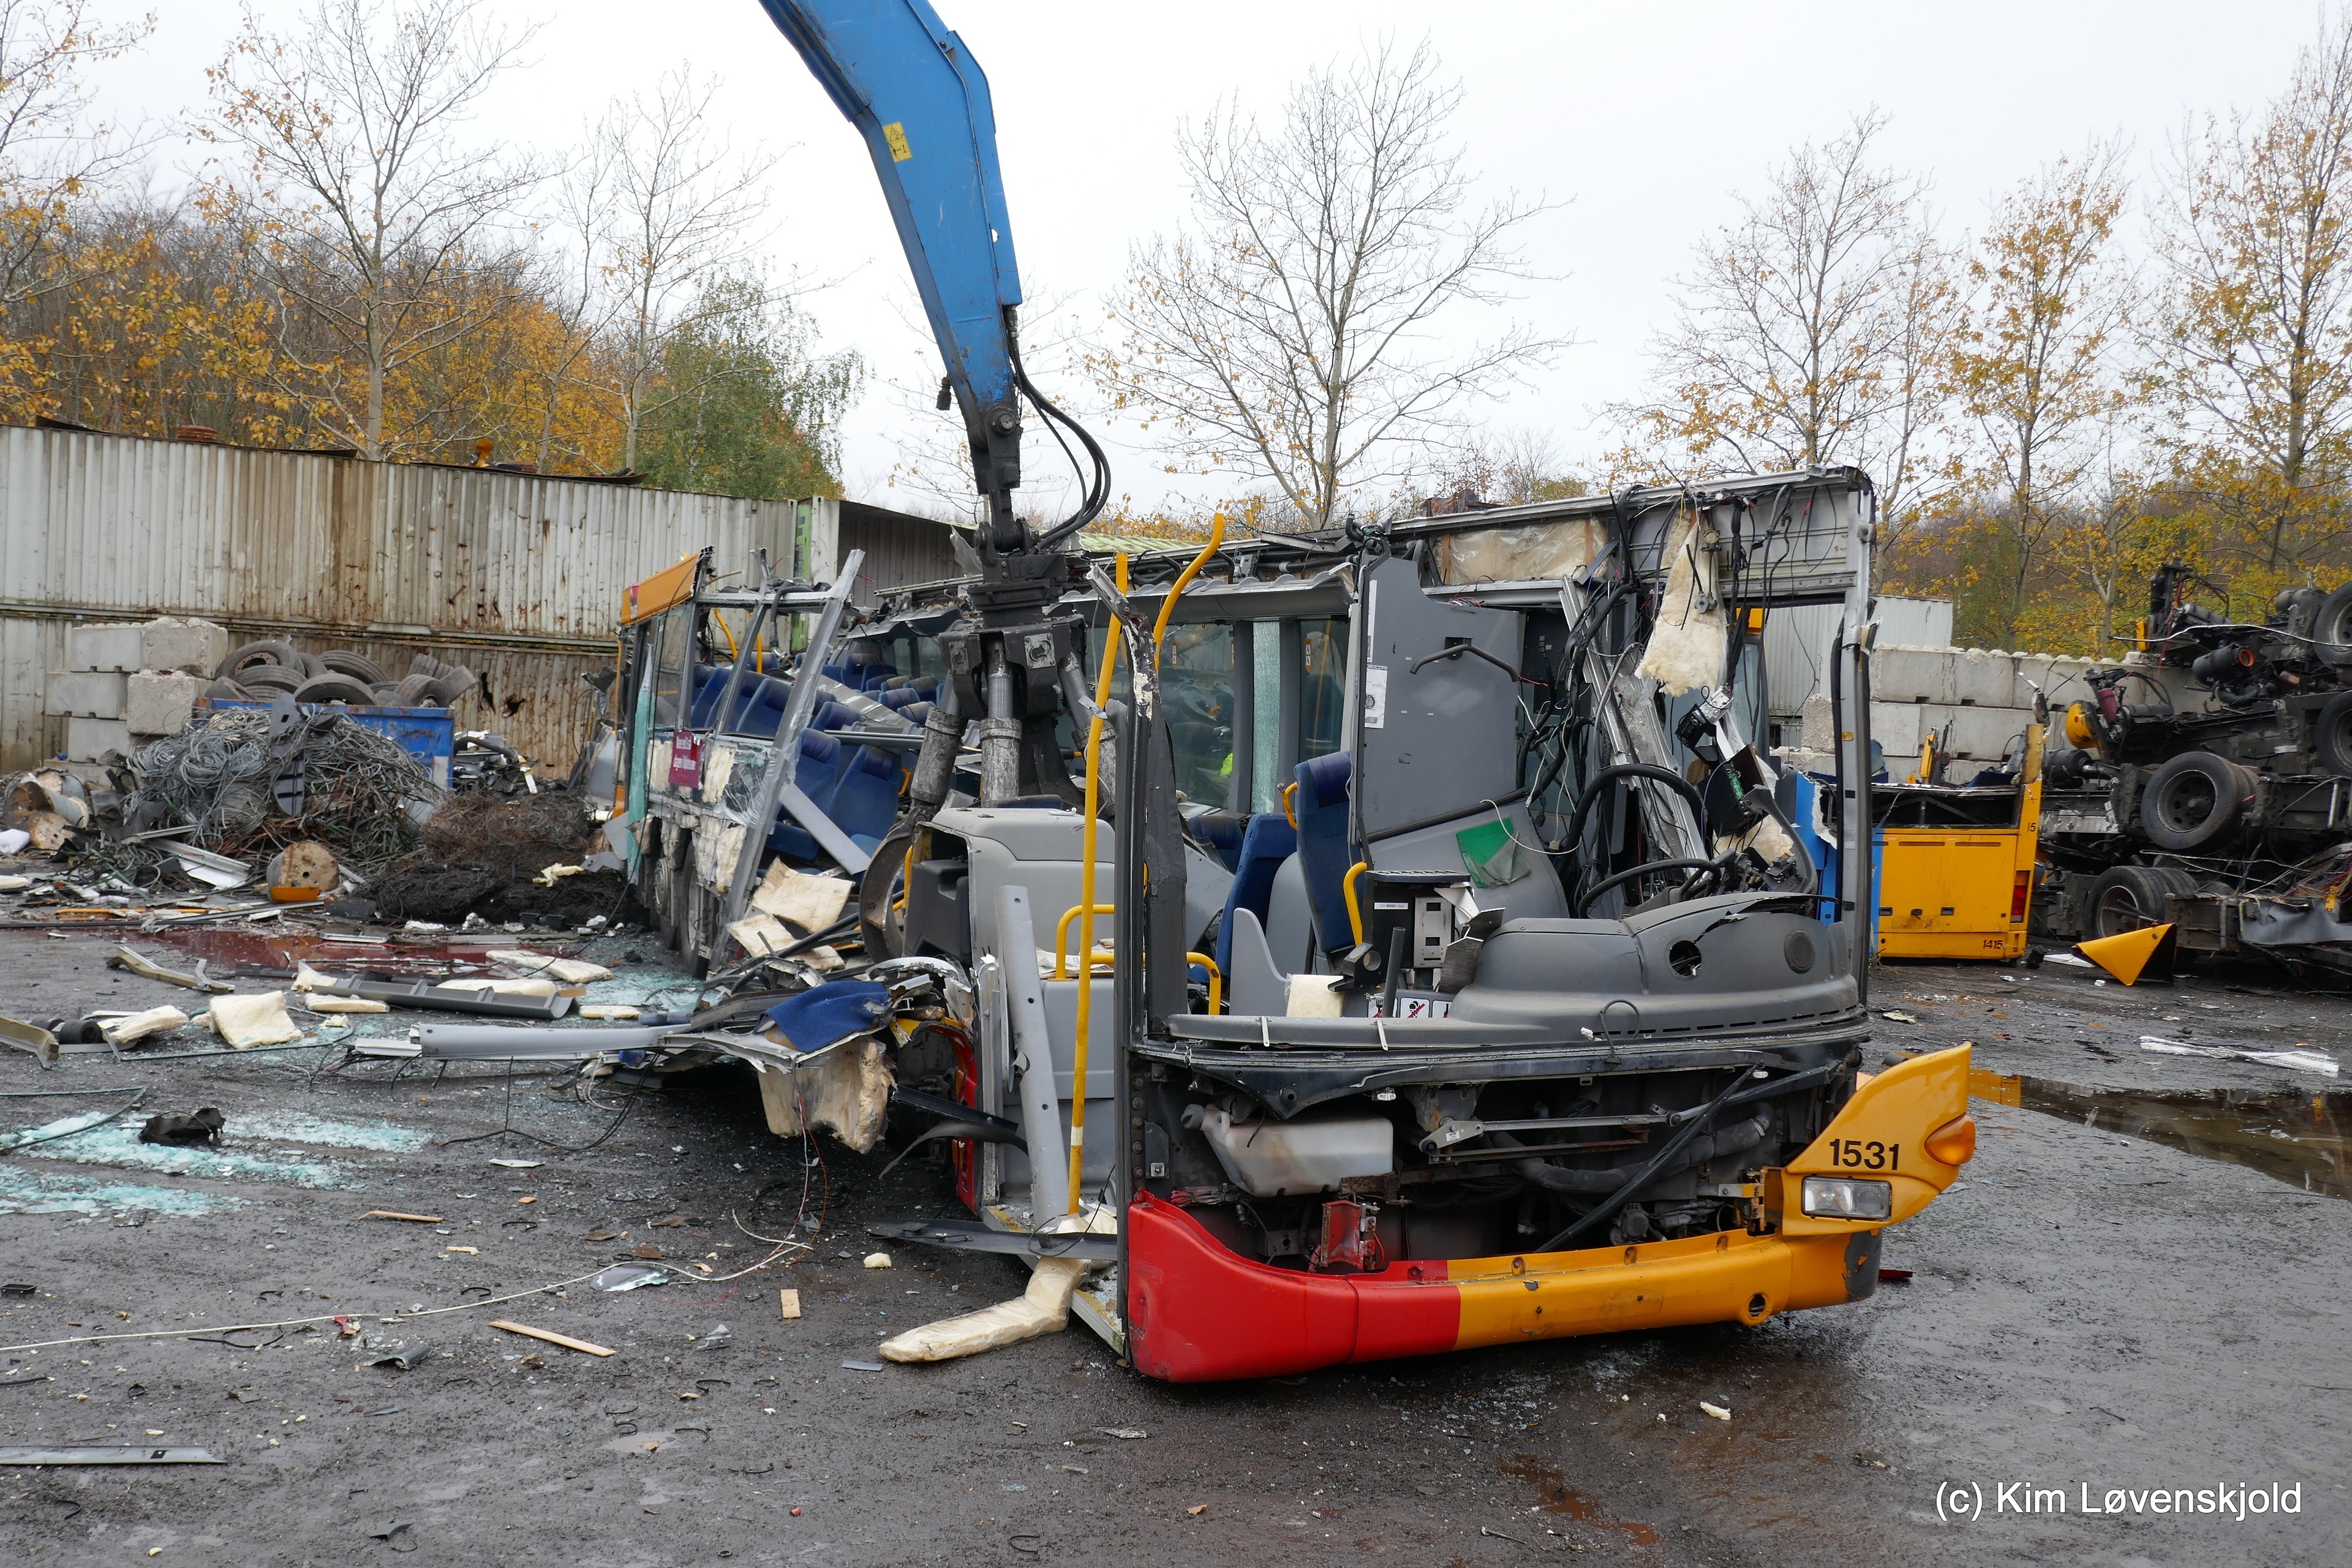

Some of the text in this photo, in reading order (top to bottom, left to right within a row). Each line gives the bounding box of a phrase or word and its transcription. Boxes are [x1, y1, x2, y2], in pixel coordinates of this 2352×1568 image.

[2027, 822, 2036, 832] 15
[1983, 939, 2003, 949] 1415
[1829, 1138, 1899, 1171] 1531
